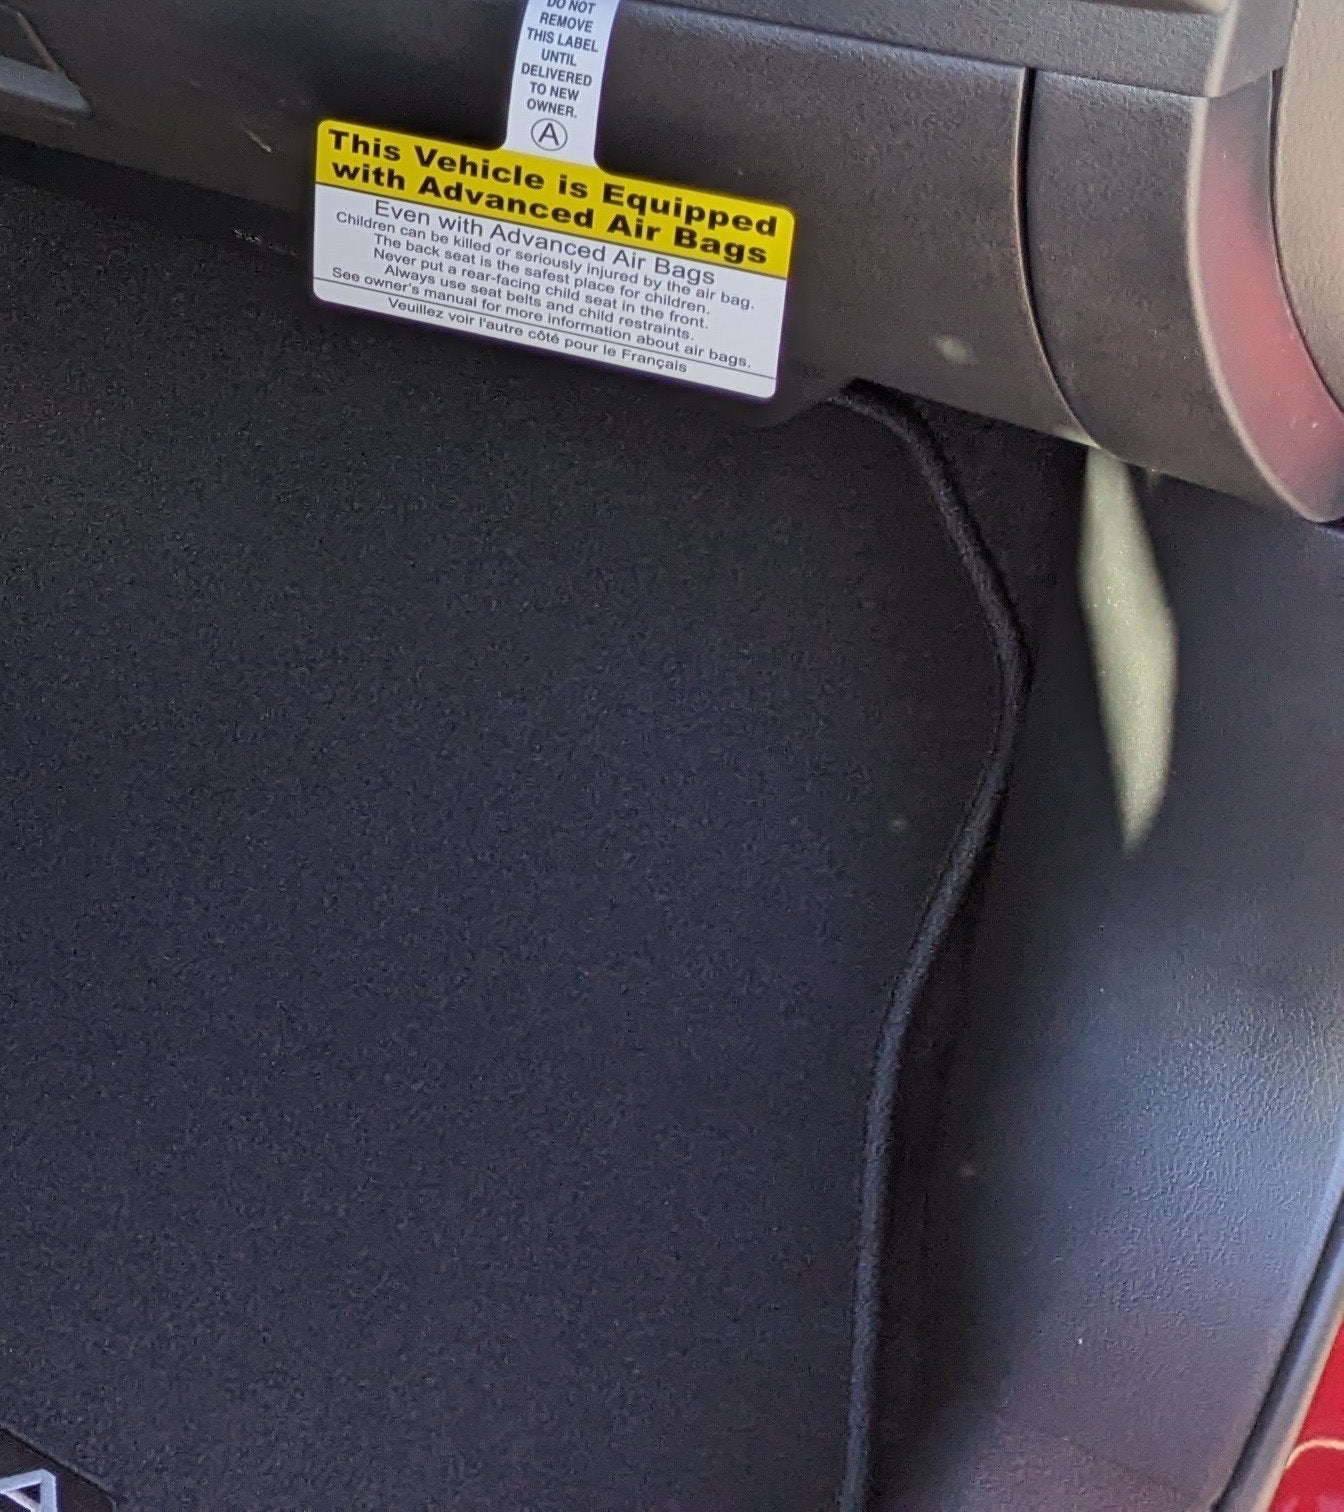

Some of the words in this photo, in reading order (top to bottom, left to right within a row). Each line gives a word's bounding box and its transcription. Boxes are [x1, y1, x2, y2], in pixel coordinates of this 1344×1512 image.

[527, 26, 554, 43] THIS
[557, 33, 597, 52] LABEL
[539, 11, 592, 32] REMOVE
[541, 48, 576, 66] UNTIL
[521, 62, 591, 86] DELIVERED
[526, 98, 576, 117] OWNER.
[530, 81, 546, 95] TO
[549, 85, 579, 100] NEW
[328, 129, 400, 160] This
[415, 145, 543, 189] Vehicle
[558, 174, 587, 198] is
[603, 183, 776, 235] Equipped
[332, 162, 404, 189] with
[419, 176, 593, 227] Advanced
[607, 214, 660, 240] Air
[674, 226, 765, 263] Bags
[336, 211, 395, 232] Children
[400, 226, 425, 239] can
[430, 230, 448, 244] be
[453, 235, 490, 252] killed
[495, 246, 510, 256] or
[515, 250, 581, 274] seriously
[586, 262, 638, 283] injured
[643, 274, 662, 291] by
[667, 280, 692, 295] the
[694, 283, 715, 299] air
[720, 291, 753, 310] bag.
[374, 232, 401, 248] The
[405, 239, 439, 256] back
[444, 250, 475, 264] seat
[479, 255, 491, 267] is
[496, 259, 519, 273] the
[524, 267, 569, 284] safest
[574, 277, 614, 293] place
[620, 284, 640, 298] for
[644, 292, 709, 314] children.
[375, 199, 429, 225] Even
[438, 216, 482, 236] with
[490, 224, 605, 261] Advanced
[612, 249, 646, 269] Air
[654, 257, 714, 285] Bags
[332, 266, 359, 282] See
[364, 276, 419, 294] owner's
[424, 288, 476, 306] manual
[481, 298, 501, 311] for
[505, 306, 542, 321] more
[547, 313, 630, 340] information
[636, 334, 679, 351] about
[684, 344, 704, 356] air
[709, 348, 750, 367] bags.
[373, 247, 416, 265] Never
[420, 259, 443, 272] put
[447, 265, 456, 274] a
[461, 268, 540, 294] rear-facing
[545, 285, 579, 301] child
[584, 294, 617, 309] seat
[621, 299, 634, 313] in
[640, 304, 663, 319] the
[669, 310, 707, 328] front.
[384, 264, 434, 284] Always
[440, 278, 466, 290] use
[470, 284, 501, 298] seat
[506, 290, 541, 307] belts
[546, 301, 573, 314] and
[578, 307, 613, 322] child
[618, 316, 693, 340] restraints.
[388, 297, 443, 318] Veuillez
[448, 312, 474, 324] voir
[479, 317, 523, 335] l'autre
[528, 330, 559, 344] côté
[564, 338, 598, 352] pour
[603, 344, 616, 356] le
[621, 348, 686, 372] Français
